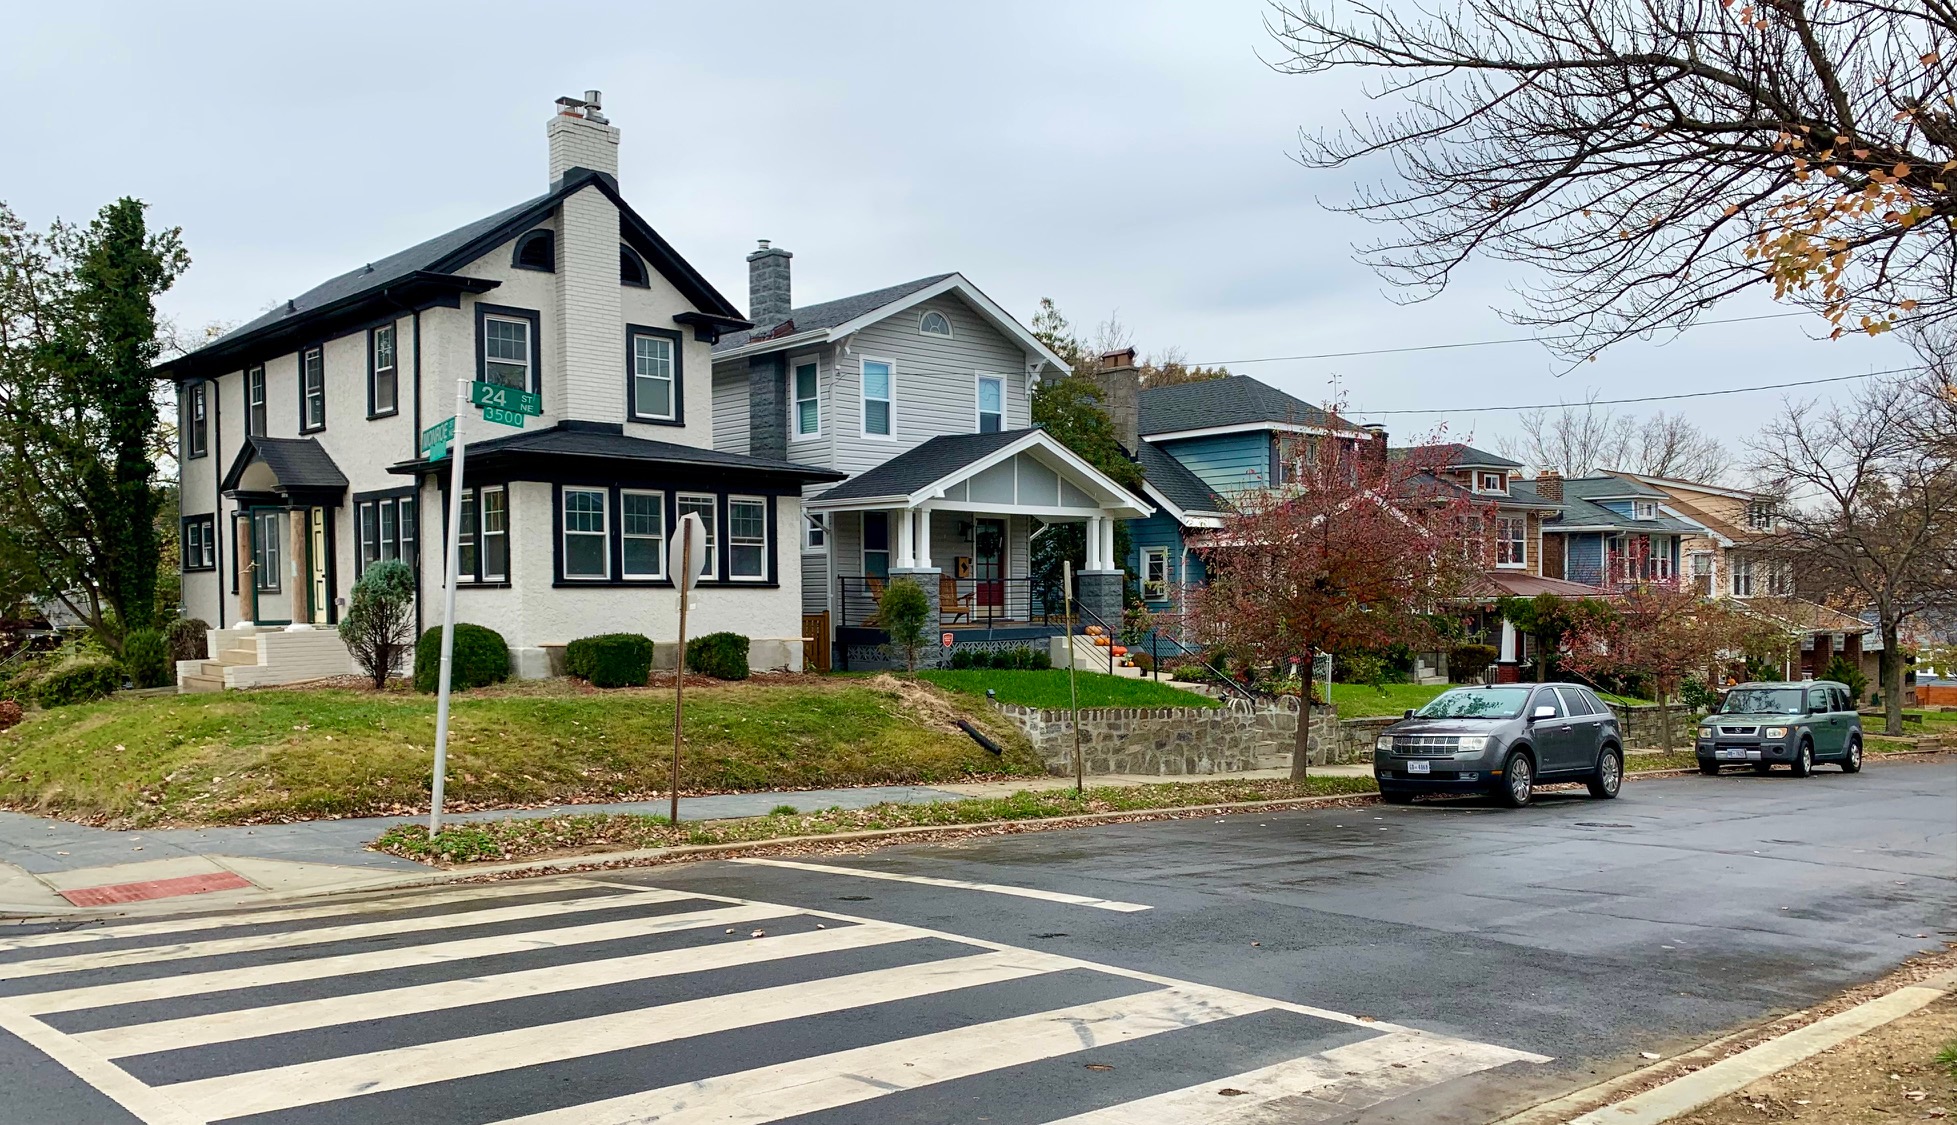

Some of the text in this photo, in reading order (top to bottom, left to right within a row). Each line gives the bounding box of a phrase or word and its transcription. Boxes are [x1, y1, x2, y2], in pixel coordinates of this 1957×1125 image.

[481, 386, 533, 406] 24 ST
[485, 407, 523, 425] 3500
[520, 403, 534, 413] NE
[423, 422, 448, 449] MONROE
